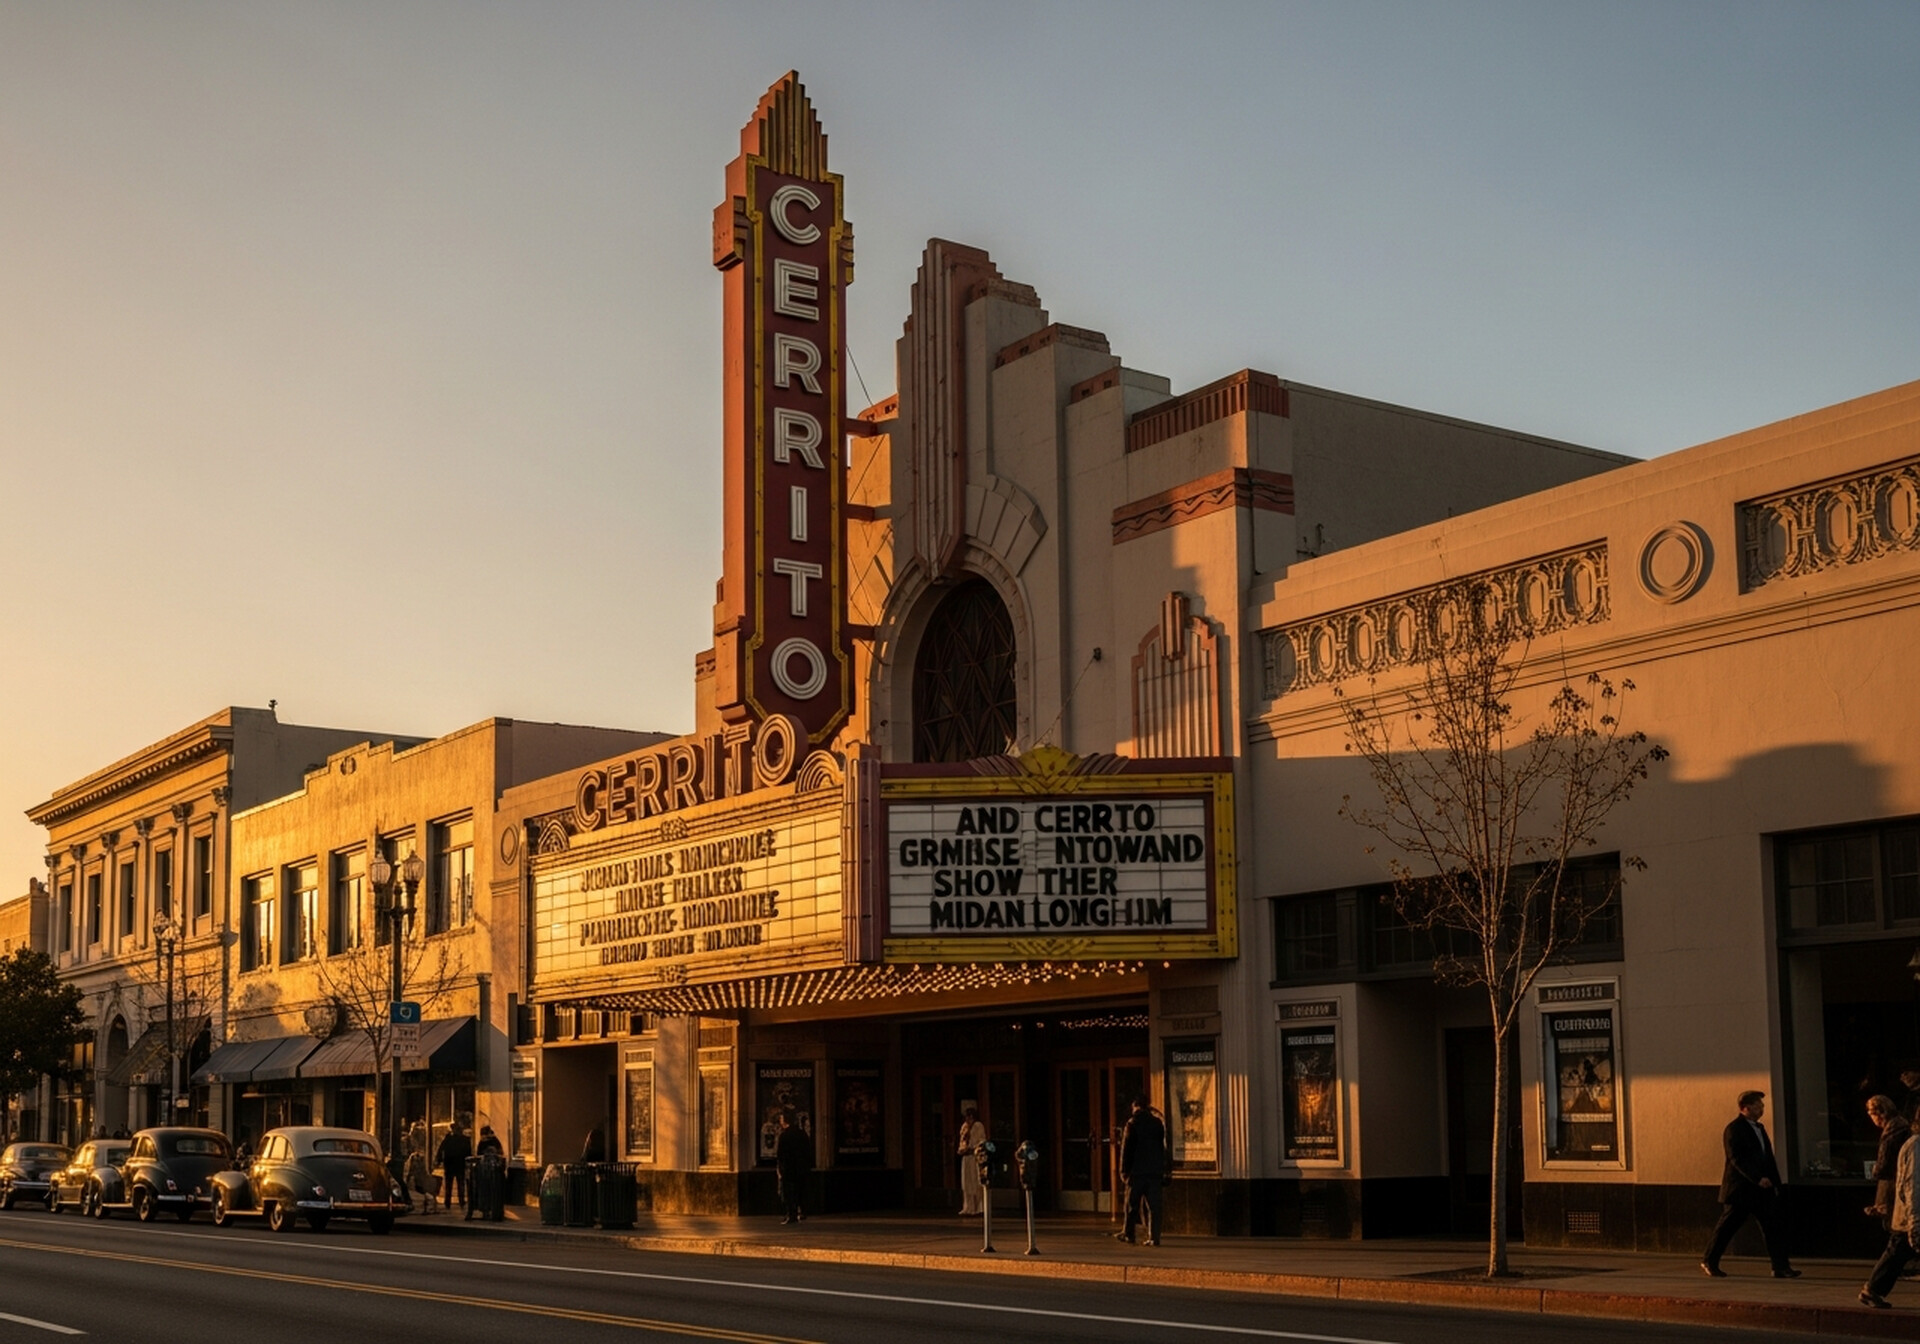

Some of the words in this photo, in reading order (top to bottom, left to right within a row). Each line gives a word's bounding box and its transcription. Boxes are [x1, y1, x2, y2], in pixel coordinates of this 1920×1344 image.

[770, 184, 827, 700] CERRITO
[574, 713, 800, 832] CERRITO
[956, 807, 1020, 835] AND
[934, 868, 1023, 897] SHOW
[1038, 867, 1118, 896] THER
[930, 899, 1025, 929] MIDAN
